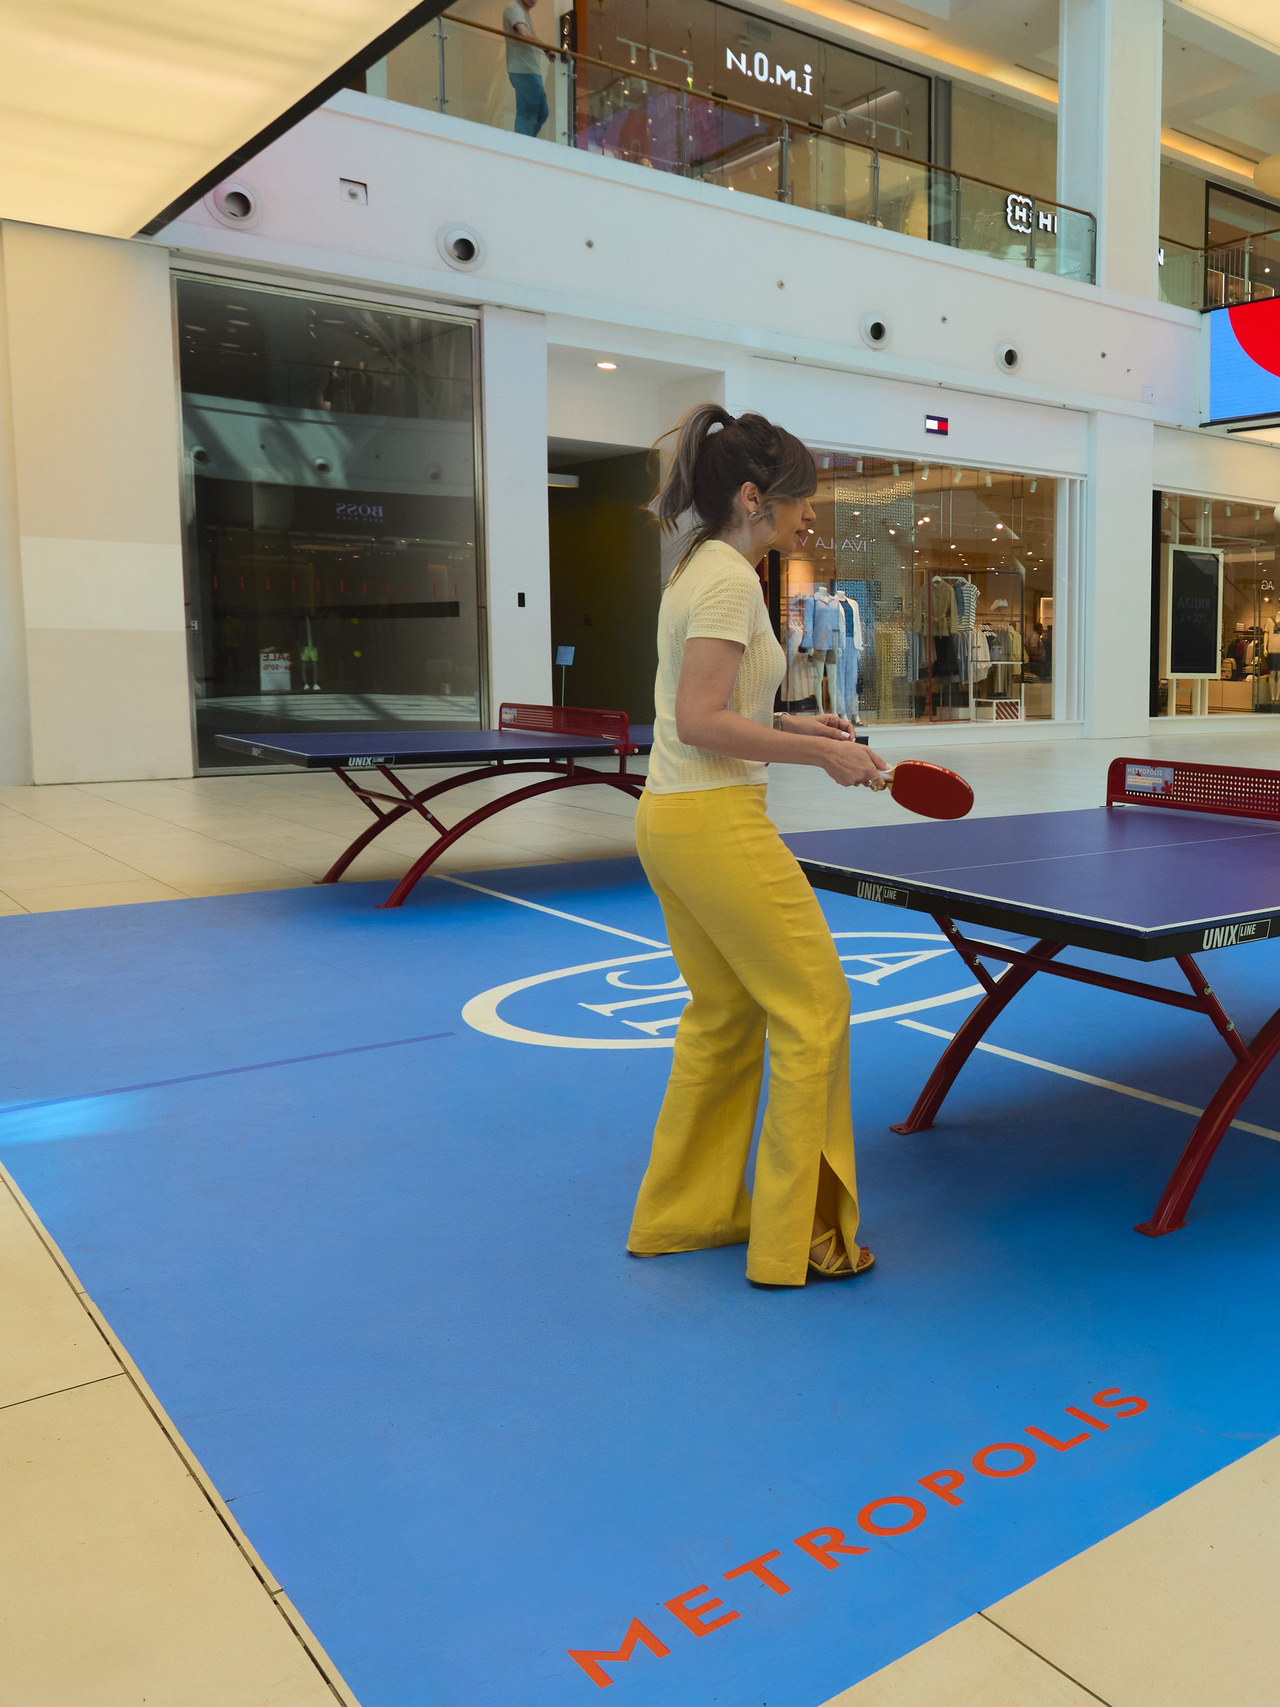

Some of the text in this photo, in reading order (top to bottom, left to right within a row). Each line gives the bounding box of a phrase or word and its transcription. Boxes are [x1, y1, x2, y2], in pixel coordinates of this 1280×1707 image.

[348, 756, 373, 767] UNIX
[857, 881, 897, 902] UNIX LINE
[1202, 924, 1257, 950] UNIX LINE
[566, 1387, 1149, 1689] METROPOLIS
